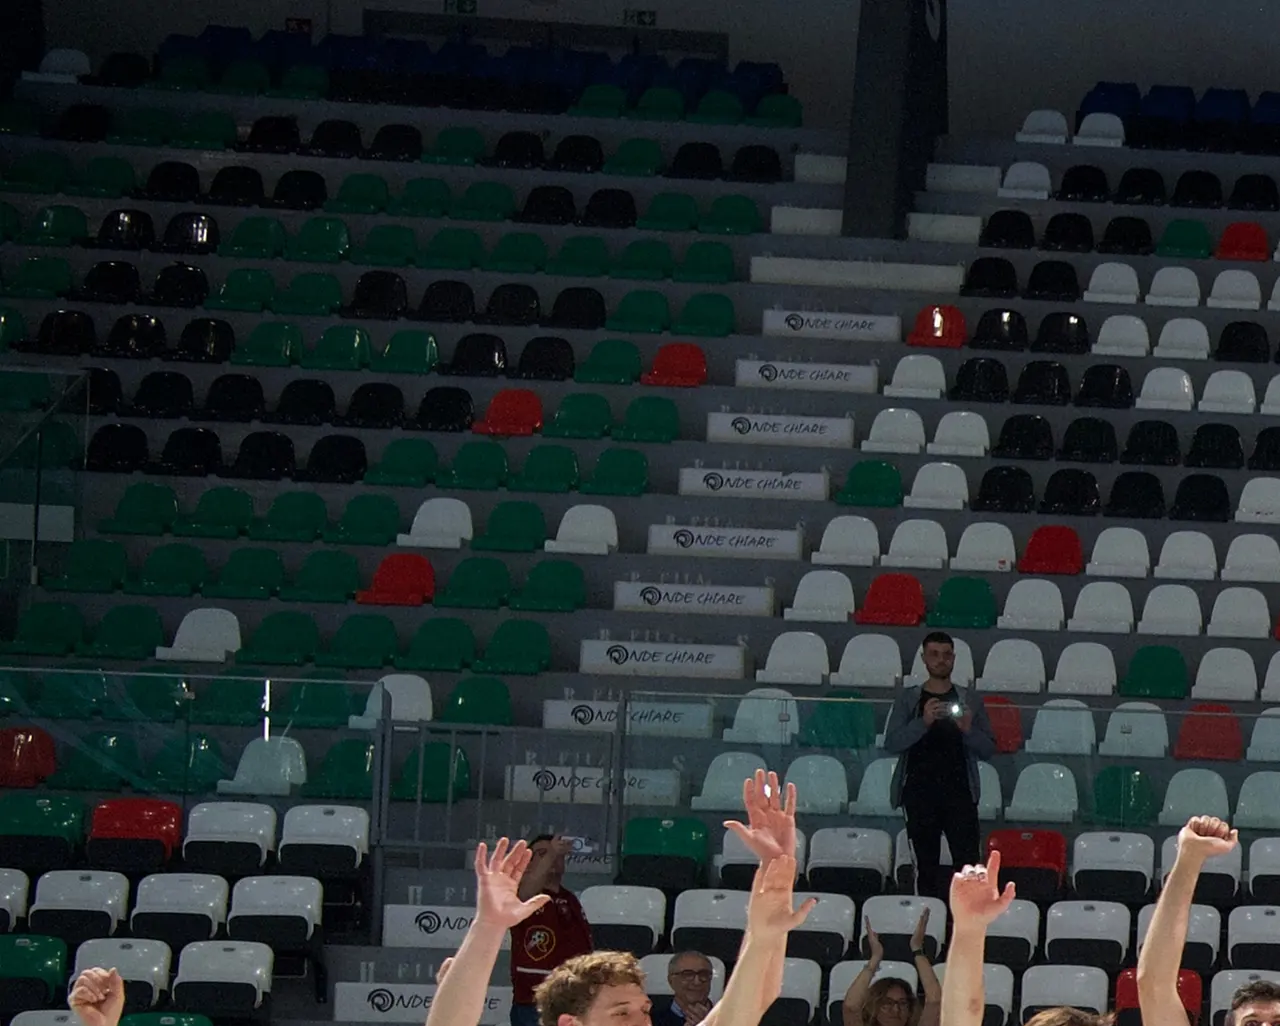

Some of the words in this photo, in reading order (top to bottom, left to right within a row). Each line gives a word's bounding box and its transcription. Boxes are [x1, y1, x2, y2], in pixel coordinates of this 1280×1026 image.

[834, 319, 874, 330] CHIARE
[808, 369, 851, 382] CHIARE
[784, 422, 827, 434] CHIARE
[756, 477, 802, 490] CHIARE
[728, 535, 777, 548] CHIARE
[696, 592, 746, 606] CHIARE
[665, 652, 716, 665] CHIARE
